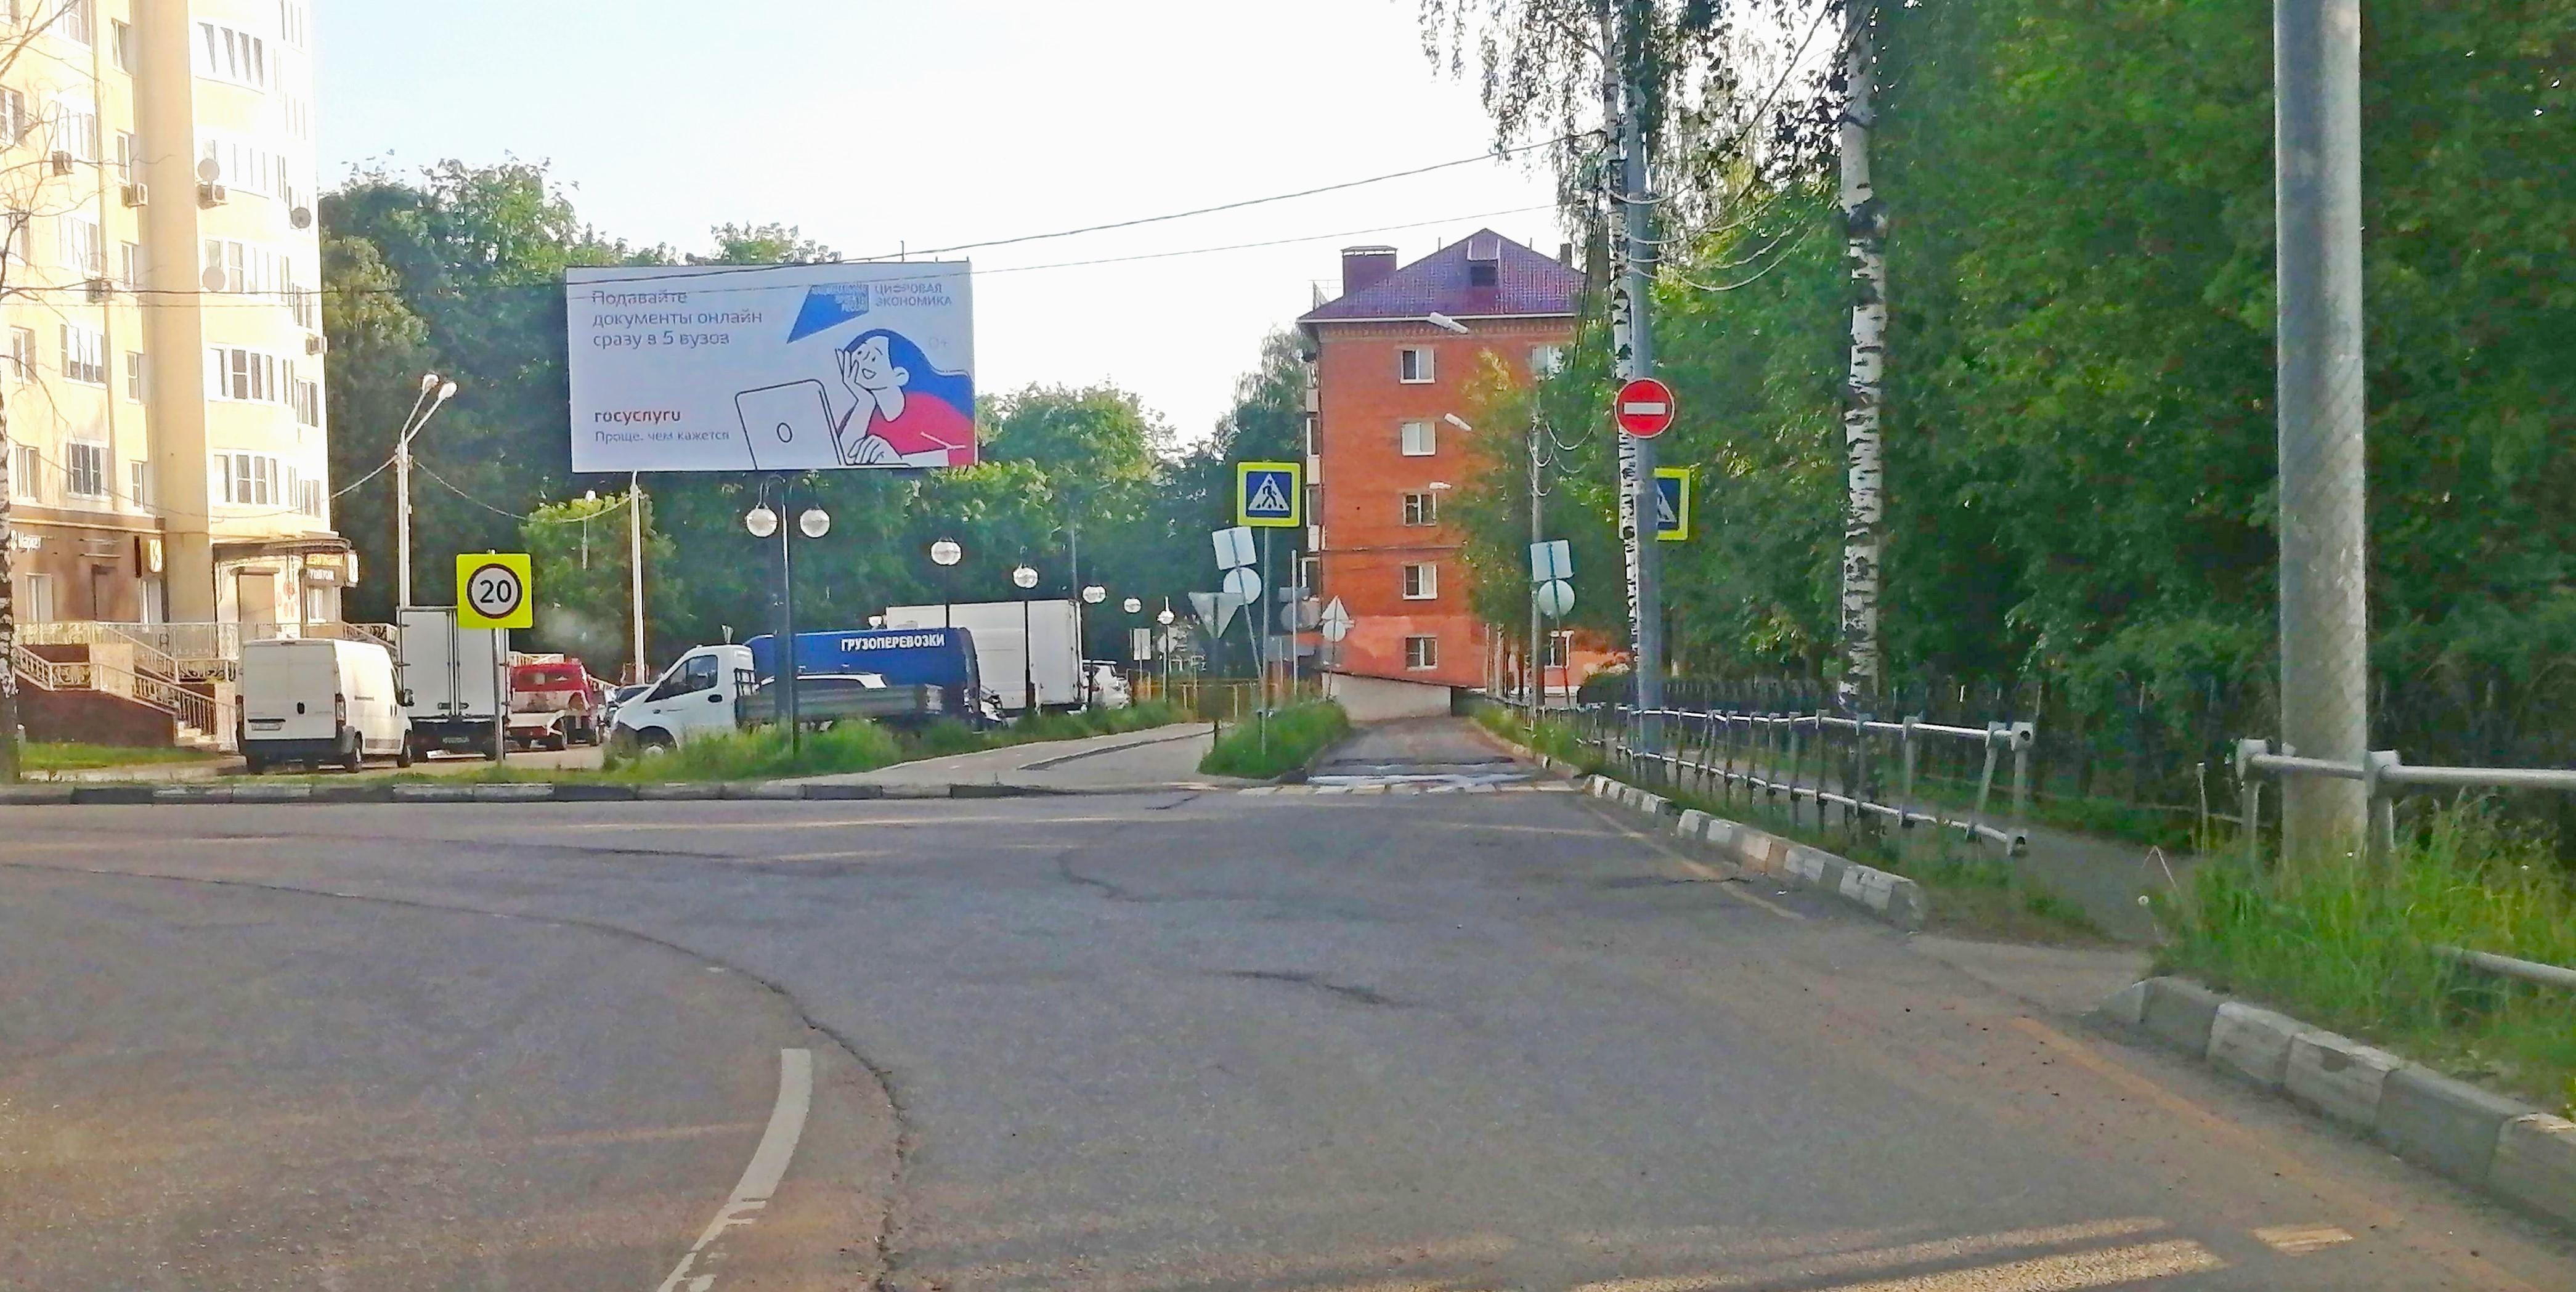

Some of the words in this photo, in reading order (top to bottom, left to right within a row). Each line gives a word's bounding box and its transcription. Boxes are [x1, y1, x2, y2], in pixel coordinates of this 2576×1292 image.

[592, 289, 688, 307] Подавайте
[876, 296, 952, 307] ЭКОНОМИКА
[593, 313, 692, 328] документы
[697, 308, 762, 325] онлайн
[593, 335, 642, 349] сразу
[648, 335, 656, 345] в
[663, 330, 673, 345] 5
[680, 333, 729, 349] вузов
[648, 432, 673, 441] чем
[678, 430, 729, 441] кажется
[479, 579, 512, 603] 20
[840, 633, 945, 652] ГРУЗОПЕРЕВОЗКИ
